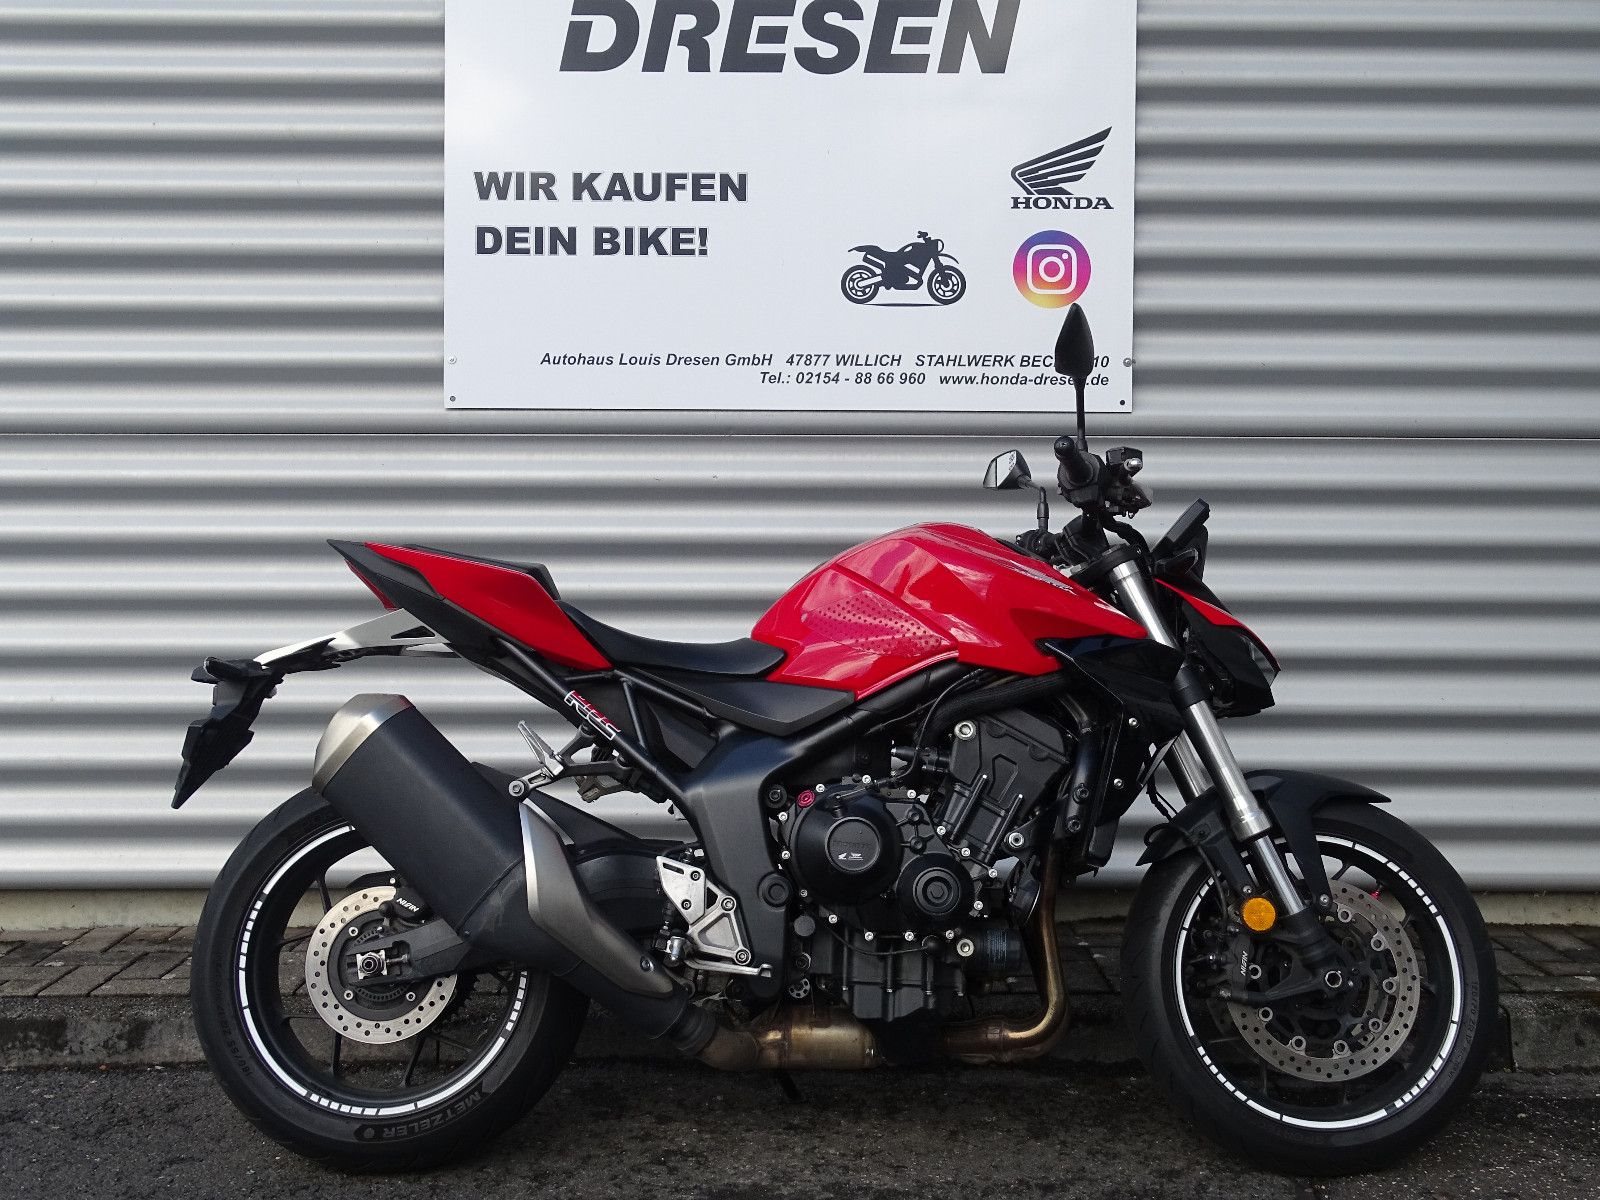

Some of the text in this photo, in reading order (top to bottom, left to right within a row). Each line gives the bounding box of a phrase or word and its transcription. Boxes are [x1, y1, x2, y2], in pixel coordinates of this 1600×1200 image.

[559, 0, 1021, 75] DRESEN
[474, 171, 747, 202] WIR KAUFEN
[1010, 196, 1114, 210] HONDA
[476, 226, 708, 257] DEIN BIKE!
[540, 352, 614, 366] Autohaus
[618, 352, 661, 366] Louis
[665, 353, 720, 366] Dresen
[725, 353, 773, 367] GmbH
[785, 353, 831, 367] 47877
[836, 353, 902, 367] WILLICH
[915, 354, 1016, 368] STAHLWERK
[1093, 355, 1110, 368] 10
[760, 371, 791, 384] Tel.:
[795, 371, 840, 385] 02154
[854, 372, 872, 385] 88
[877, 372, 894, 385] 66
[899, 372, 926, 385] 960
[939, 372, 1109, 386] www.honda-drese.de
[382, 1090, 482, 1138] METZELER
